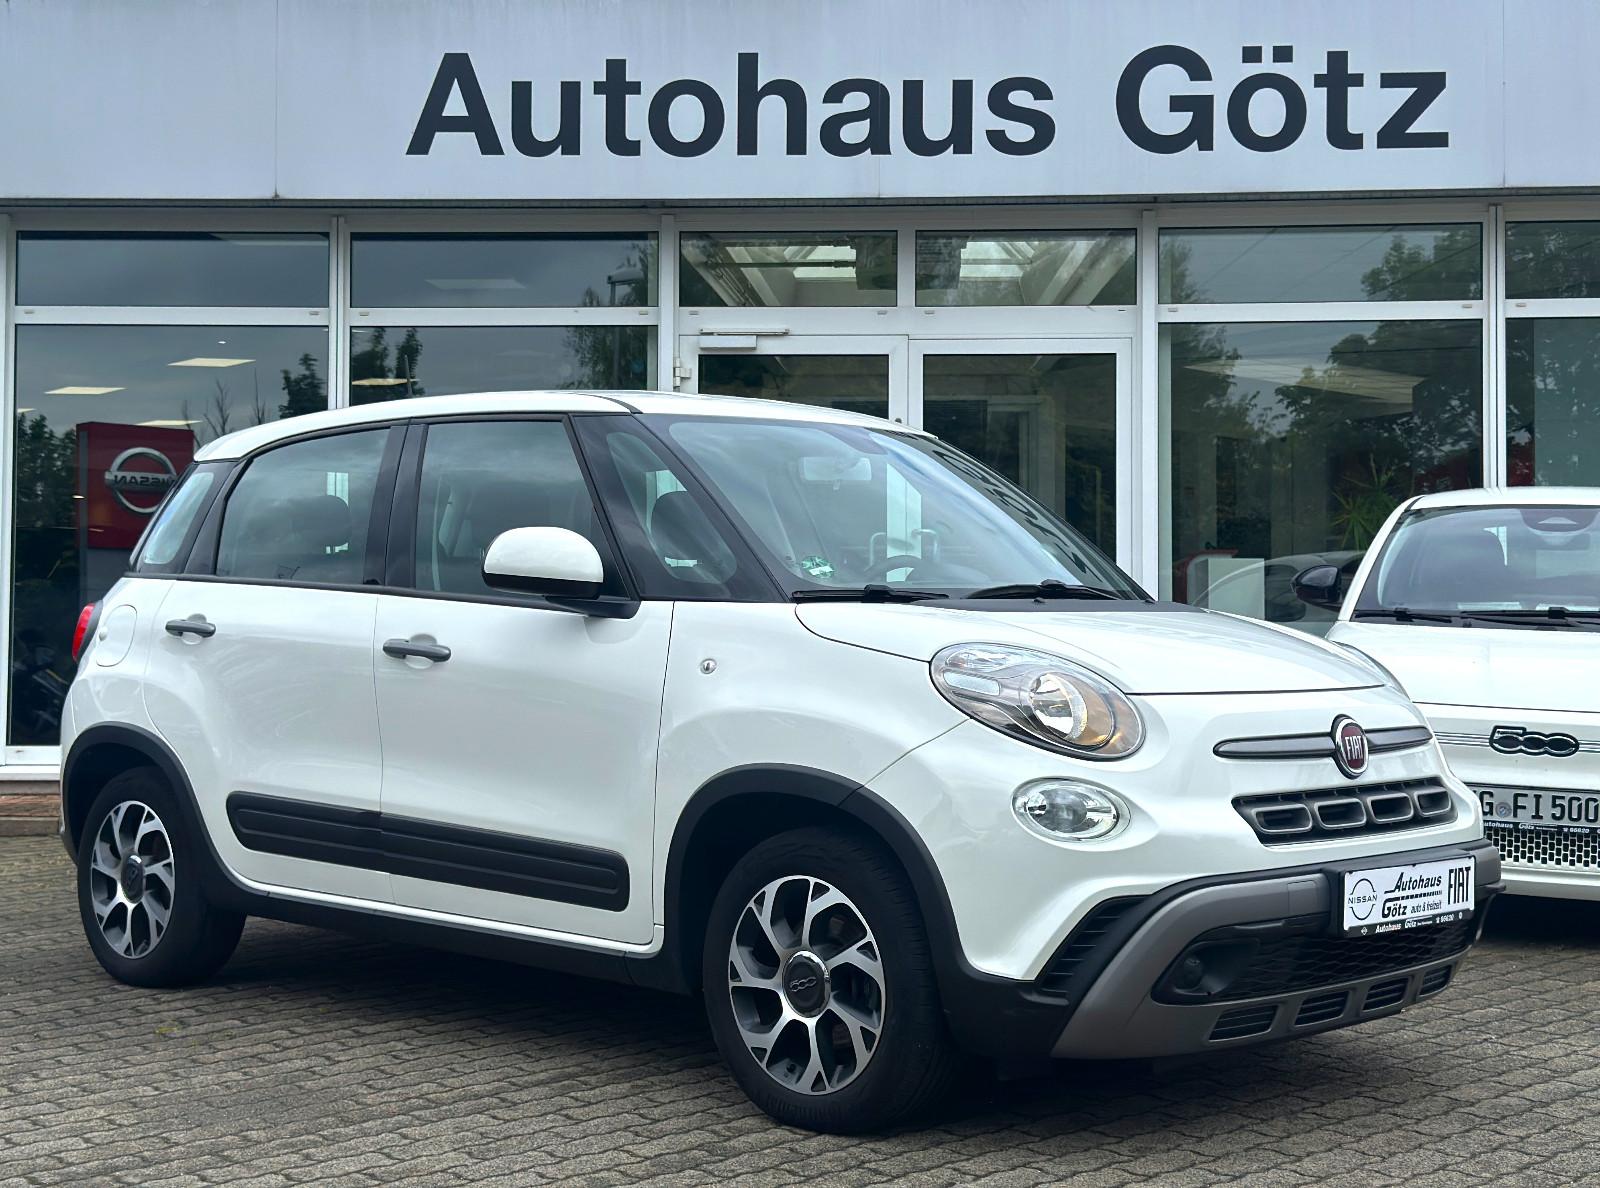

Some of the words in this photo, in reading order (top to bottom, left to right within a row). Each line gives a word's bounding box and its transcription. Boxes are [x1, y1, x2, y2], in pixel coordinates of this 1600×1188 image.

[405, 52, 1056, 157] Autohaus
[1116, 45, 1449, 154] Götz
[1345, 735, 1363, 760] FIAT
[1489, 725, 1580, 757] 500
[1473, 790, 1494, 816] G
[1385, 872, 1442, 894] Autohaus
[1448, 866, 1471, 905] FIAT
[1348, 894, 1378, 904] NISSAN
[1382, 896, 1407, 918] Götz
[1375, 922, 1402, 933] Autohaus
